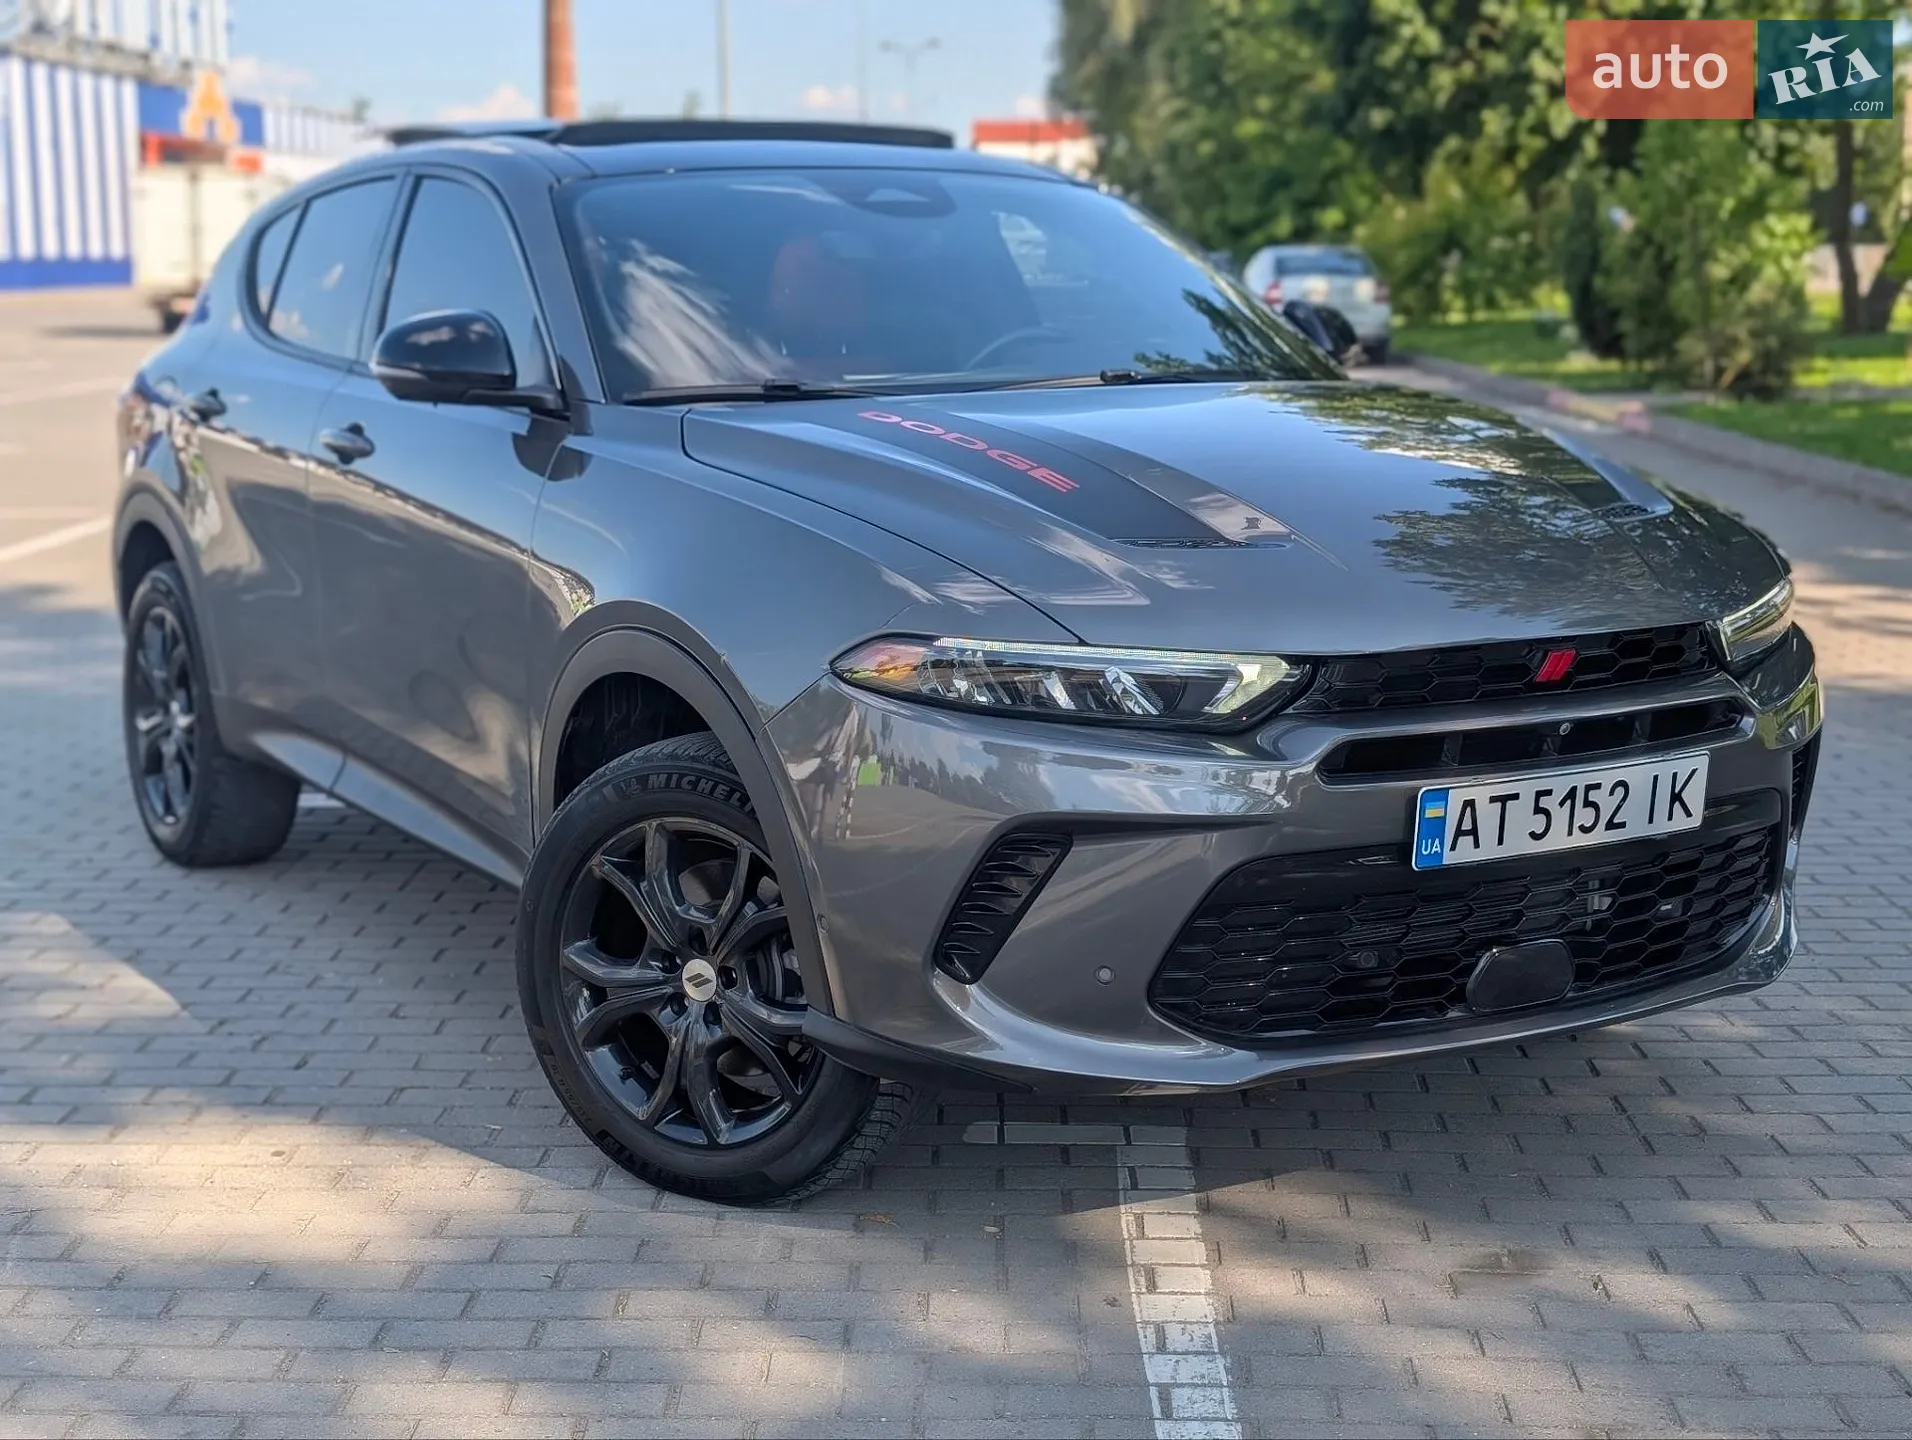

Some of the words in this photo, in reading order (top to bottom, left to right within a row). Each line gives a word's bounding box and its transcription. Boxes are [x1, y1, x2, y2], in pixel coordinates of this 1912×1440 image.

[857, 411, 1080, 493] DODGE
[646, 773, 754, 813] MICHELI
[1449, 792, 1520, 852] AT
[1528, 779, 1630, 841] 5152
[1647, 767, 1698, 825] IK
[1421, 839, 1441, 855] UA
